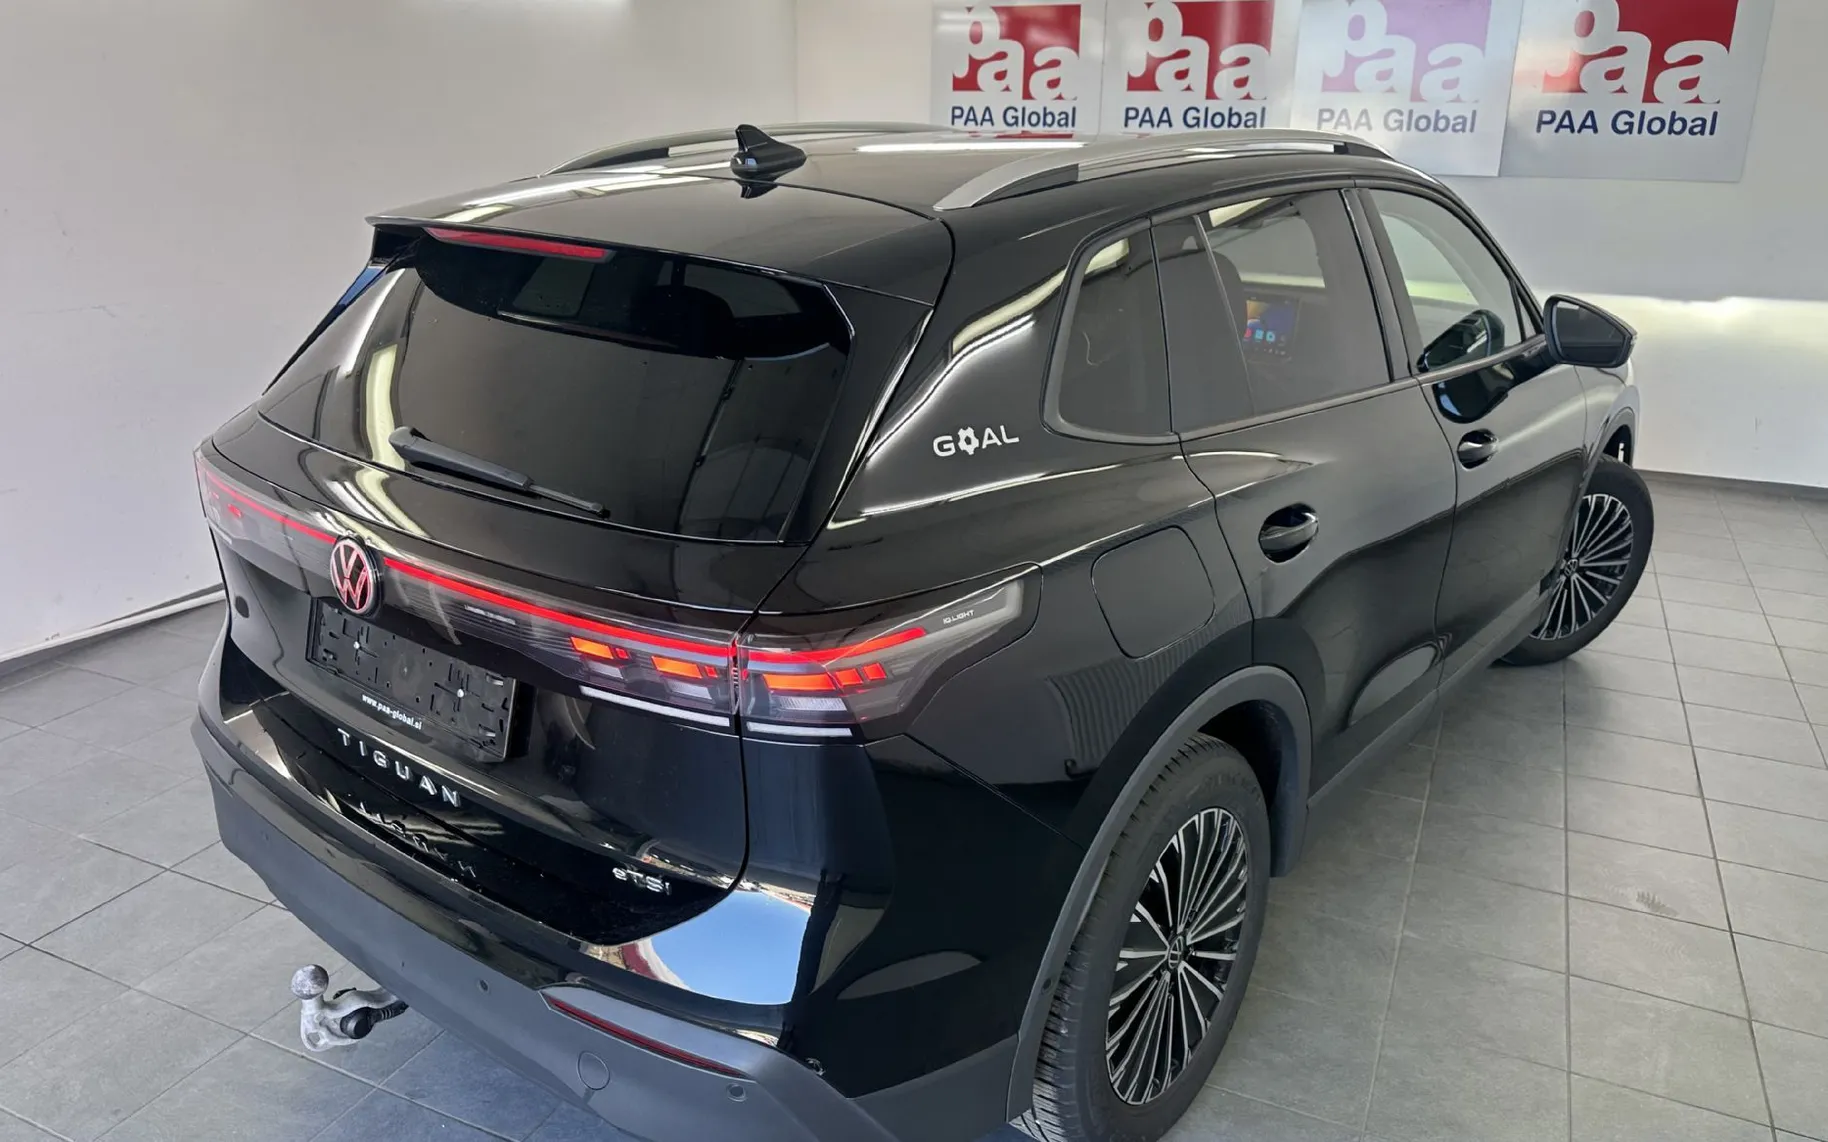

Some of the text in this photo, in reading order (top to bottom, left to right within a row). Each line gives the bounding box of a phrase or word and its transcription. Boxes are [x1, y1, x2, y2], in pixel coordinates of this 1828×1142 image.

[951, 106, 1077, 128] PAA Global
[1123, 106, 1267, 129] PAA Global
[1316, 108, 1477, 134] PAA Global
[1535, 109, 1718, 136] PAA Global
[362, 694, 423, 730] www.paa-global.si
[337, 727, 461, 808] TIGUAN
